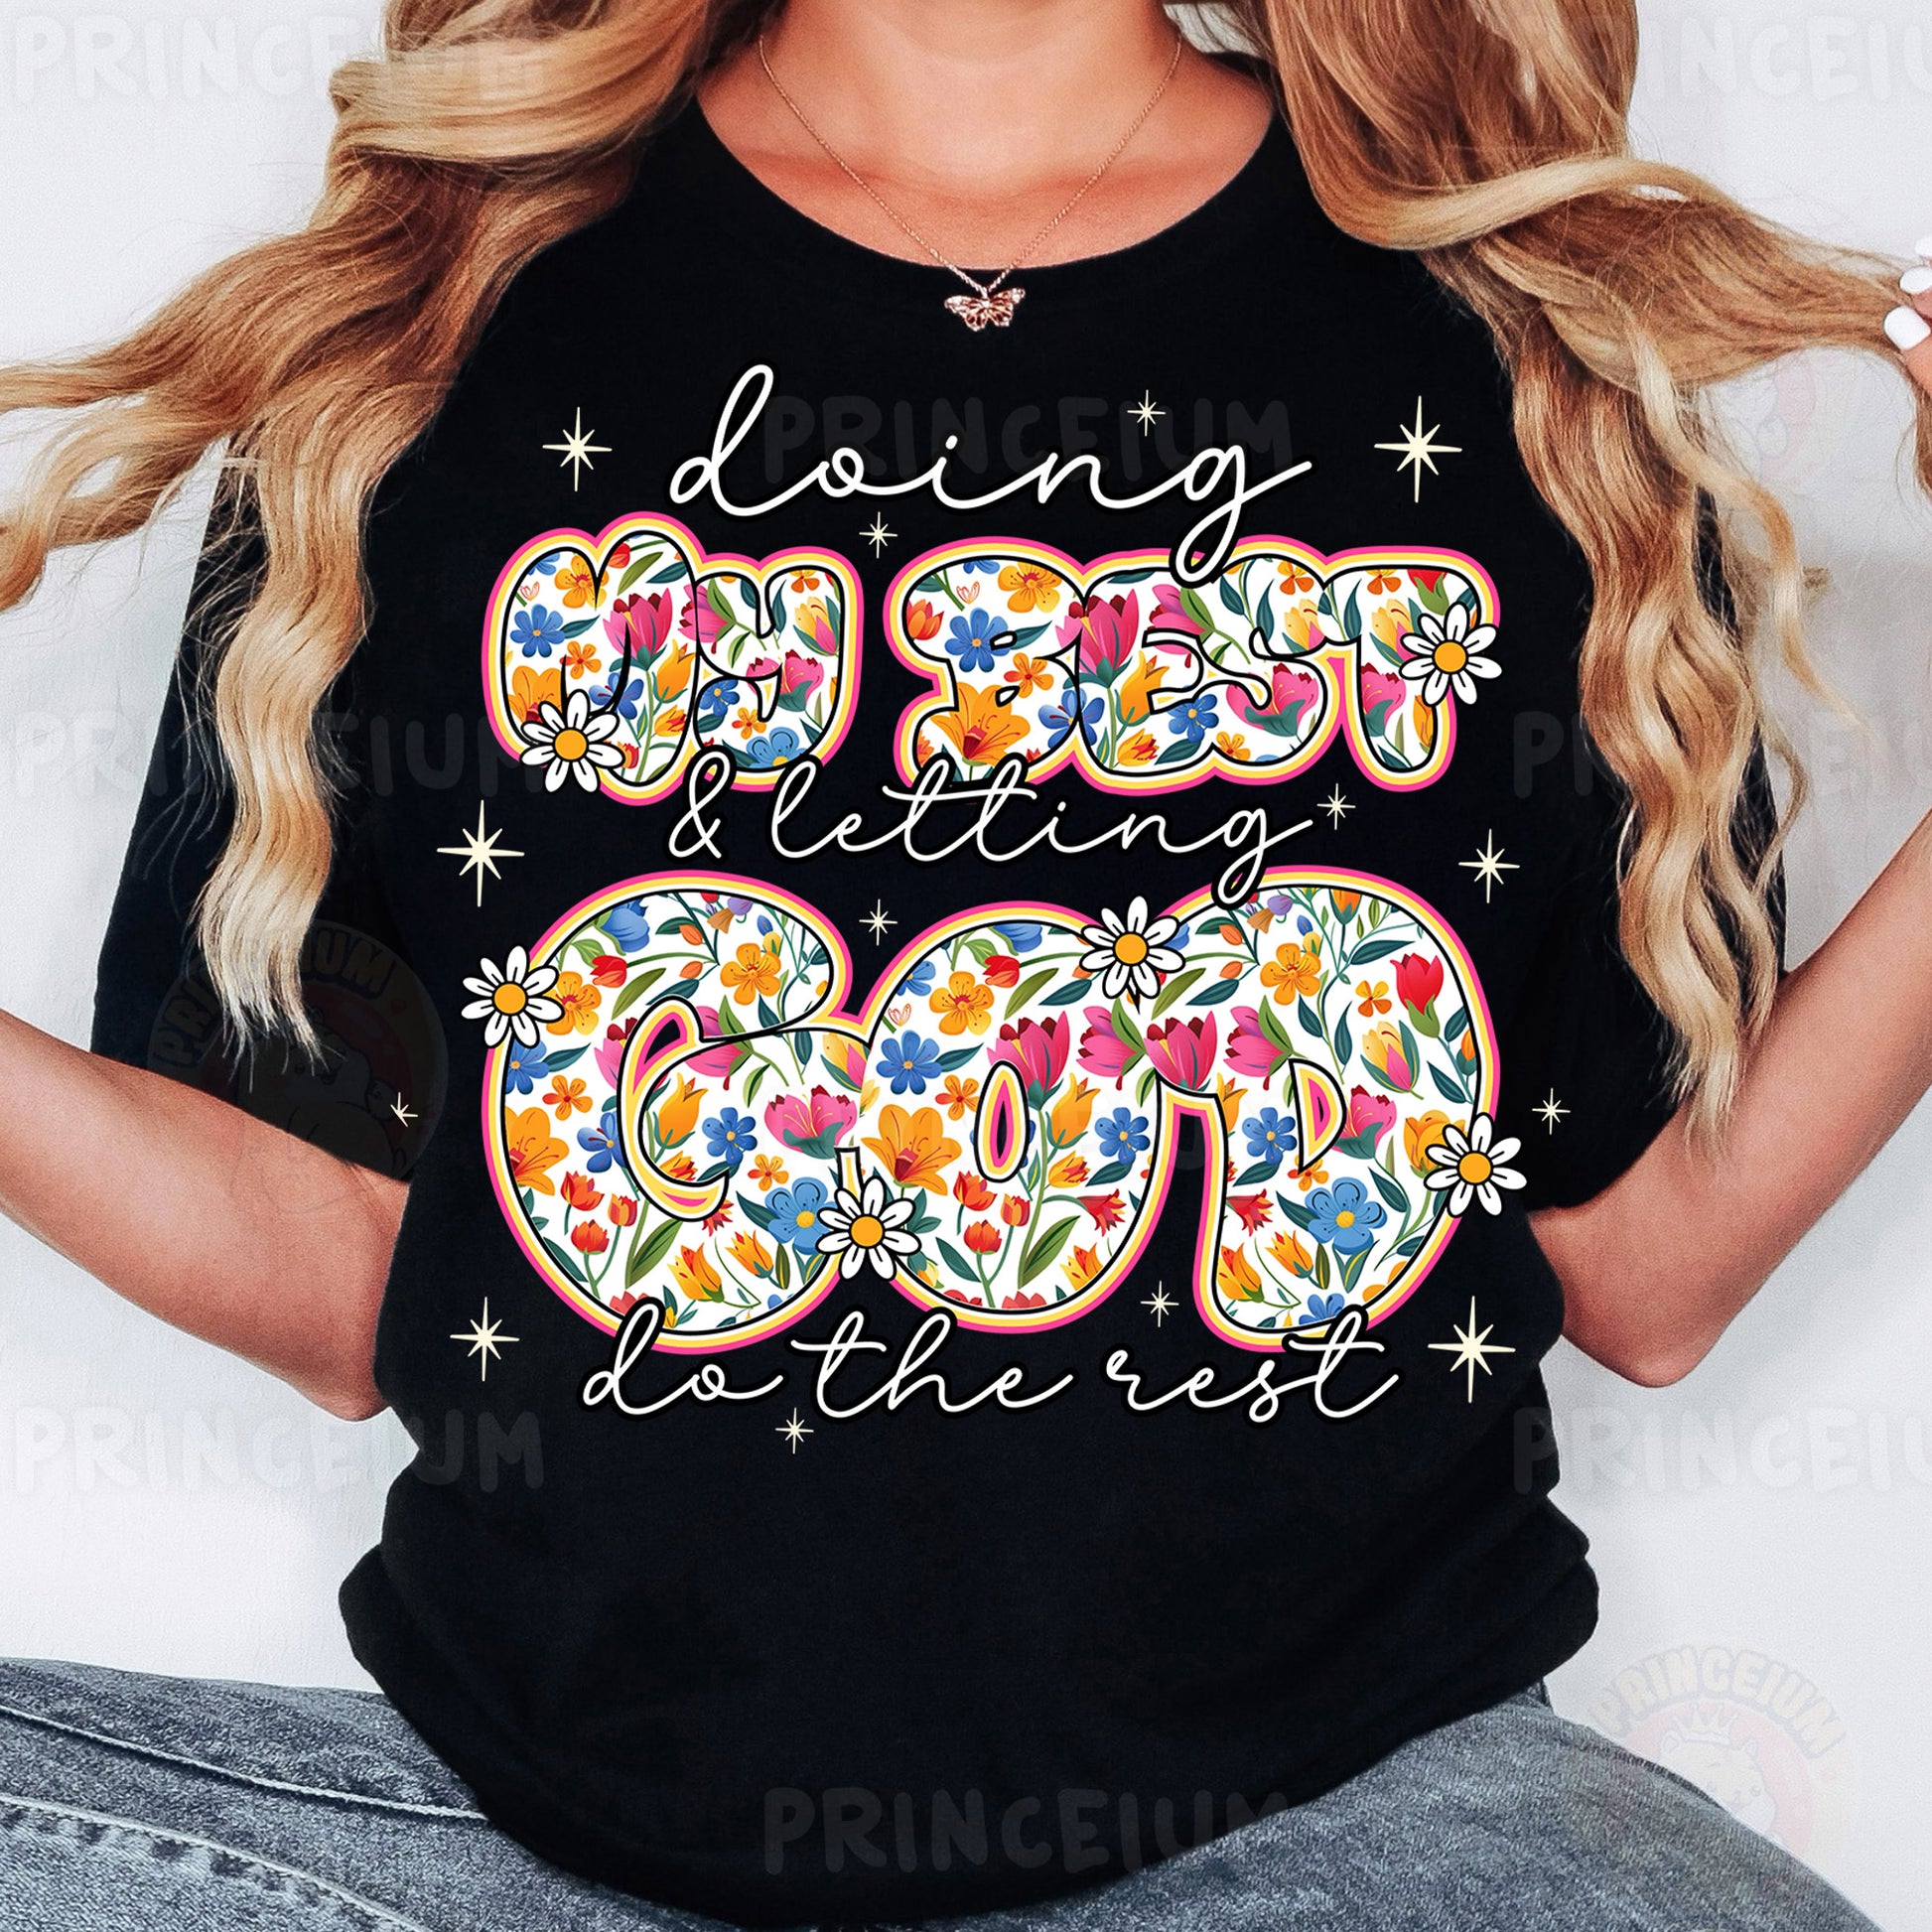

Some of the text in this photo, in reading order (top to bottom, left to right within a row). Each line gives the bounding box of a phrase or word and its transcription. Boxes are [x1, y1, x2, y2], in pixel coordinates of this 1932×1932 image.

[667, 362, 1313, 584] doing
[483, 512, 1501, 805] MY BEST
[667, 757, 1313, 905] & letting
[483, 864, 1501, 1354] GOD
[581, 1307, 1401, 1424] do the rest
